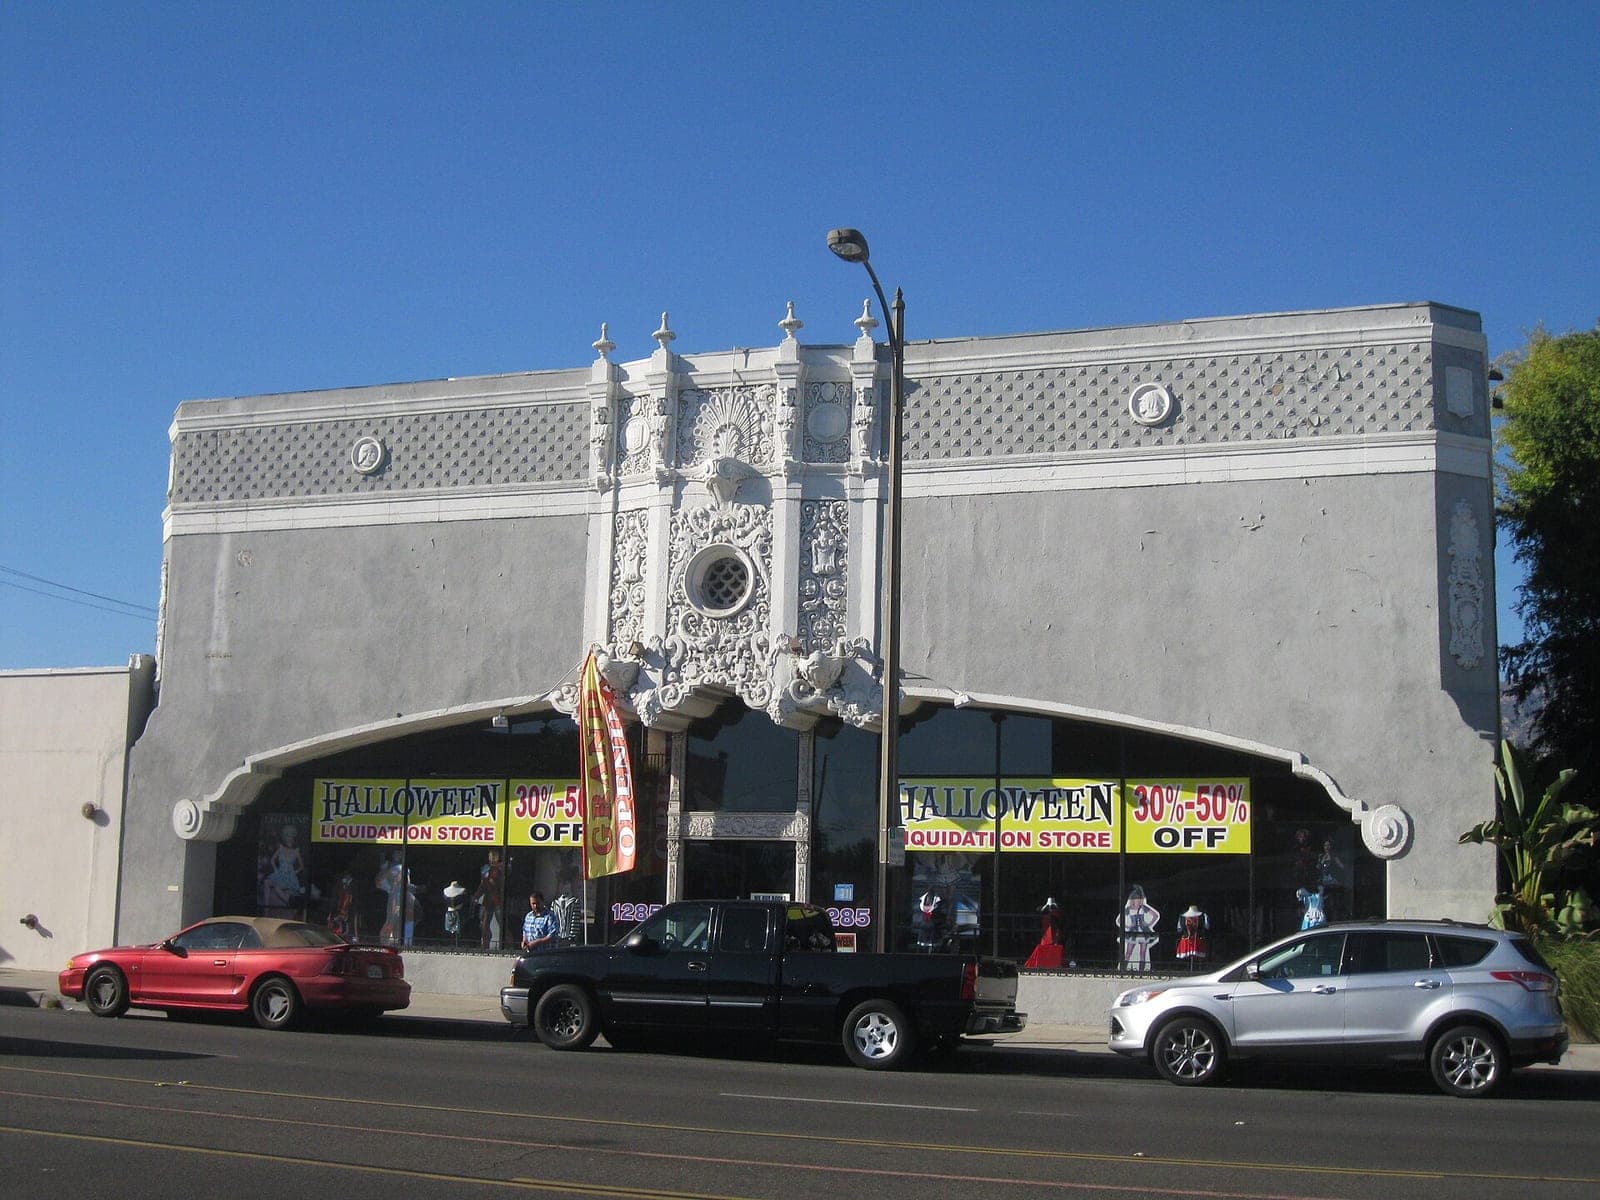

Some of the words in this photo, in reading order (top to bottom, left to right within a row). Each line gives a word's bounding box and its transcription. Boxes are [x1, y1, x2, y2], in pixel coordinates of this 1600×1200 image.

[587, 688, 614, 857] GRAND
[319, 781, 501, 822] HALLOWEEN
[898, 782, 1117, 827] HALLOWEEN
[1134, 784, 1247, 823] 30%-50%
[320, 824, 432, 840] LIQUIDATION
[437, 826, 494, 841] STORE
[530, 823, 583, 842] OFF
[903, 830, 1031, 847] IQUIDATION
[1038, 831, 1111, 847] STORE
[1153, 827, 1227, 848] OFF
[825, 907, 871, 927] 285
